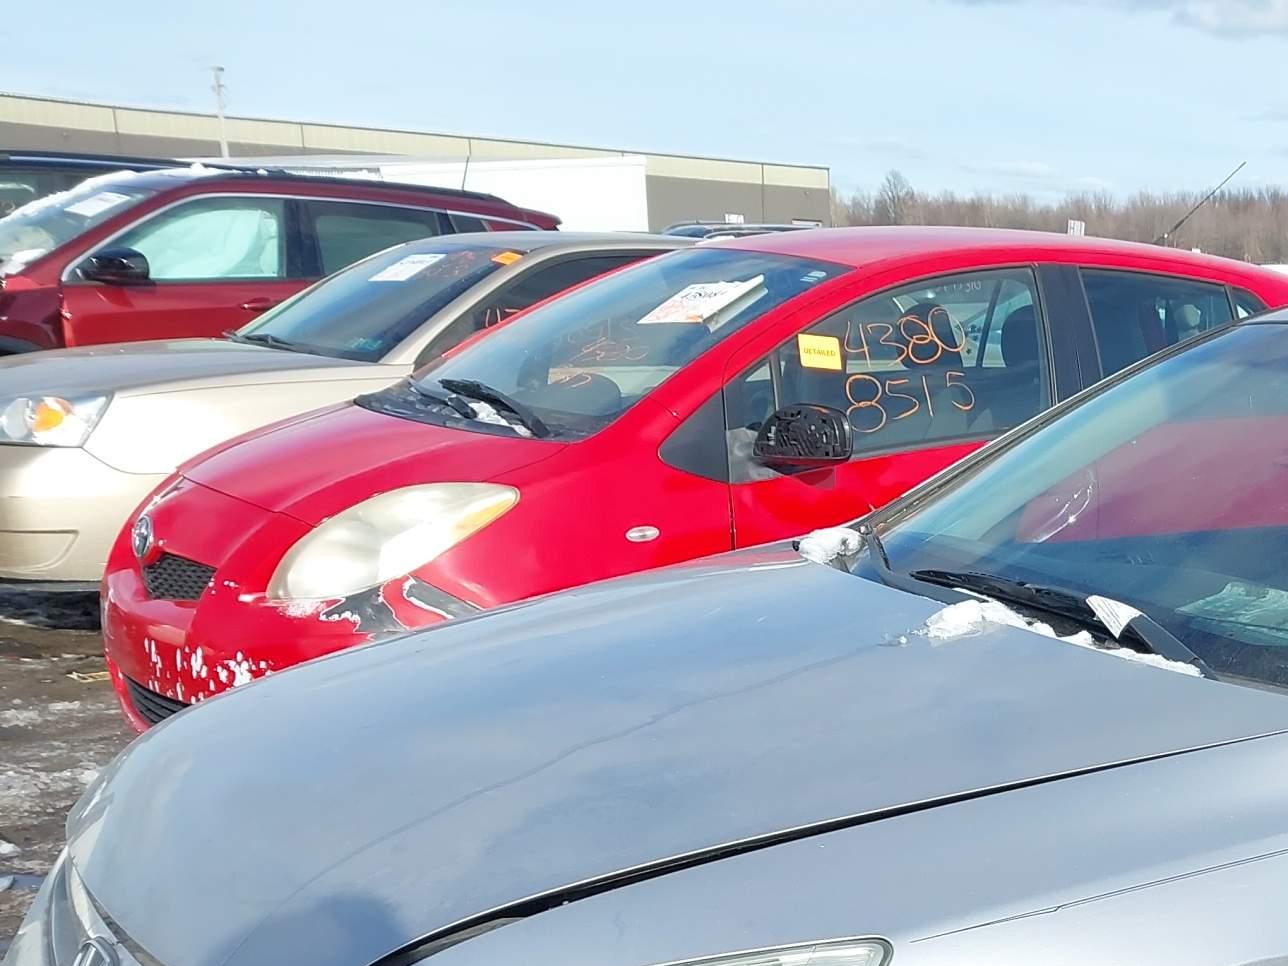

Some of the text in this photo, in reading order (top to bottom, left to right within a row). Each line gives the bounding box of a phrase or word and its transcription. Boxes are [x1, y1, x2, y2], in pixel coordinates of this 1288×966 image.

[803, 347, 836, 357] DETAILED
[843, 306, 966, 369] 4380
[845, 371, 976, 433] 8515
